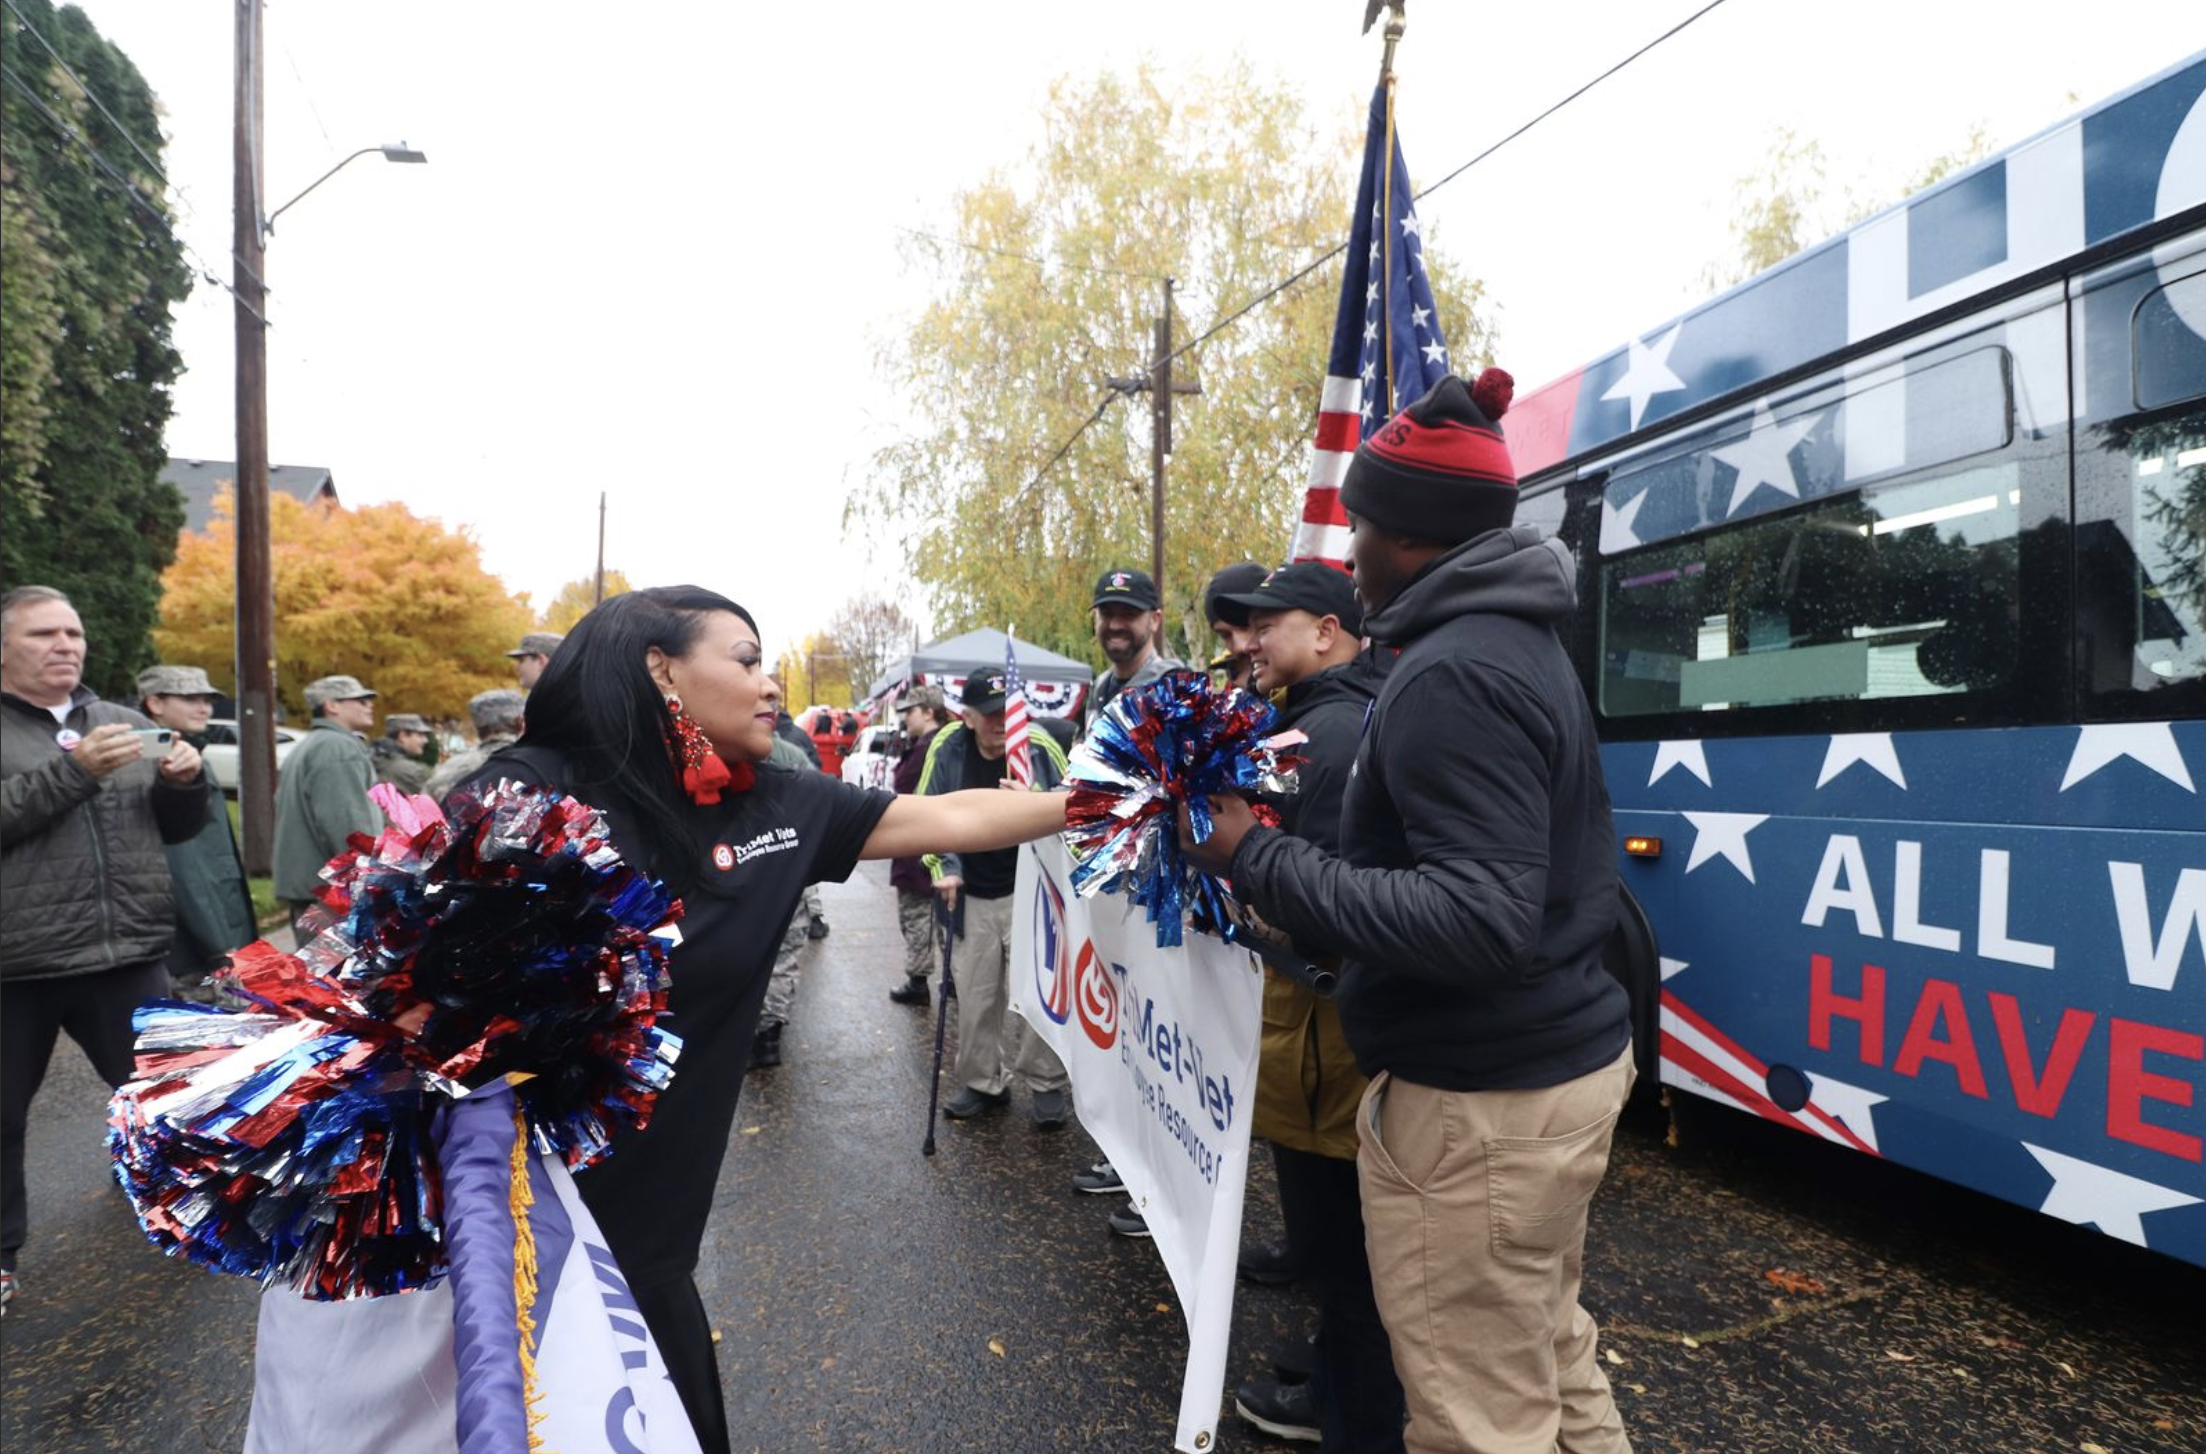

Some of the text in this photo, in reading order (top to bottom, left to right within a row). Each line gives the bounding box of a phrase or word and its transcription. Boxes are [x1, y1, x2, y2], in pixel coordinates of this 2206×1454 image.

[733, 831, 775, 858] TriMet
[1801, 833, 2055, 970] ALL
[1808, 952, 2205, 1164] HAVE
[1158, 1083, 1212, 1184] Resource
